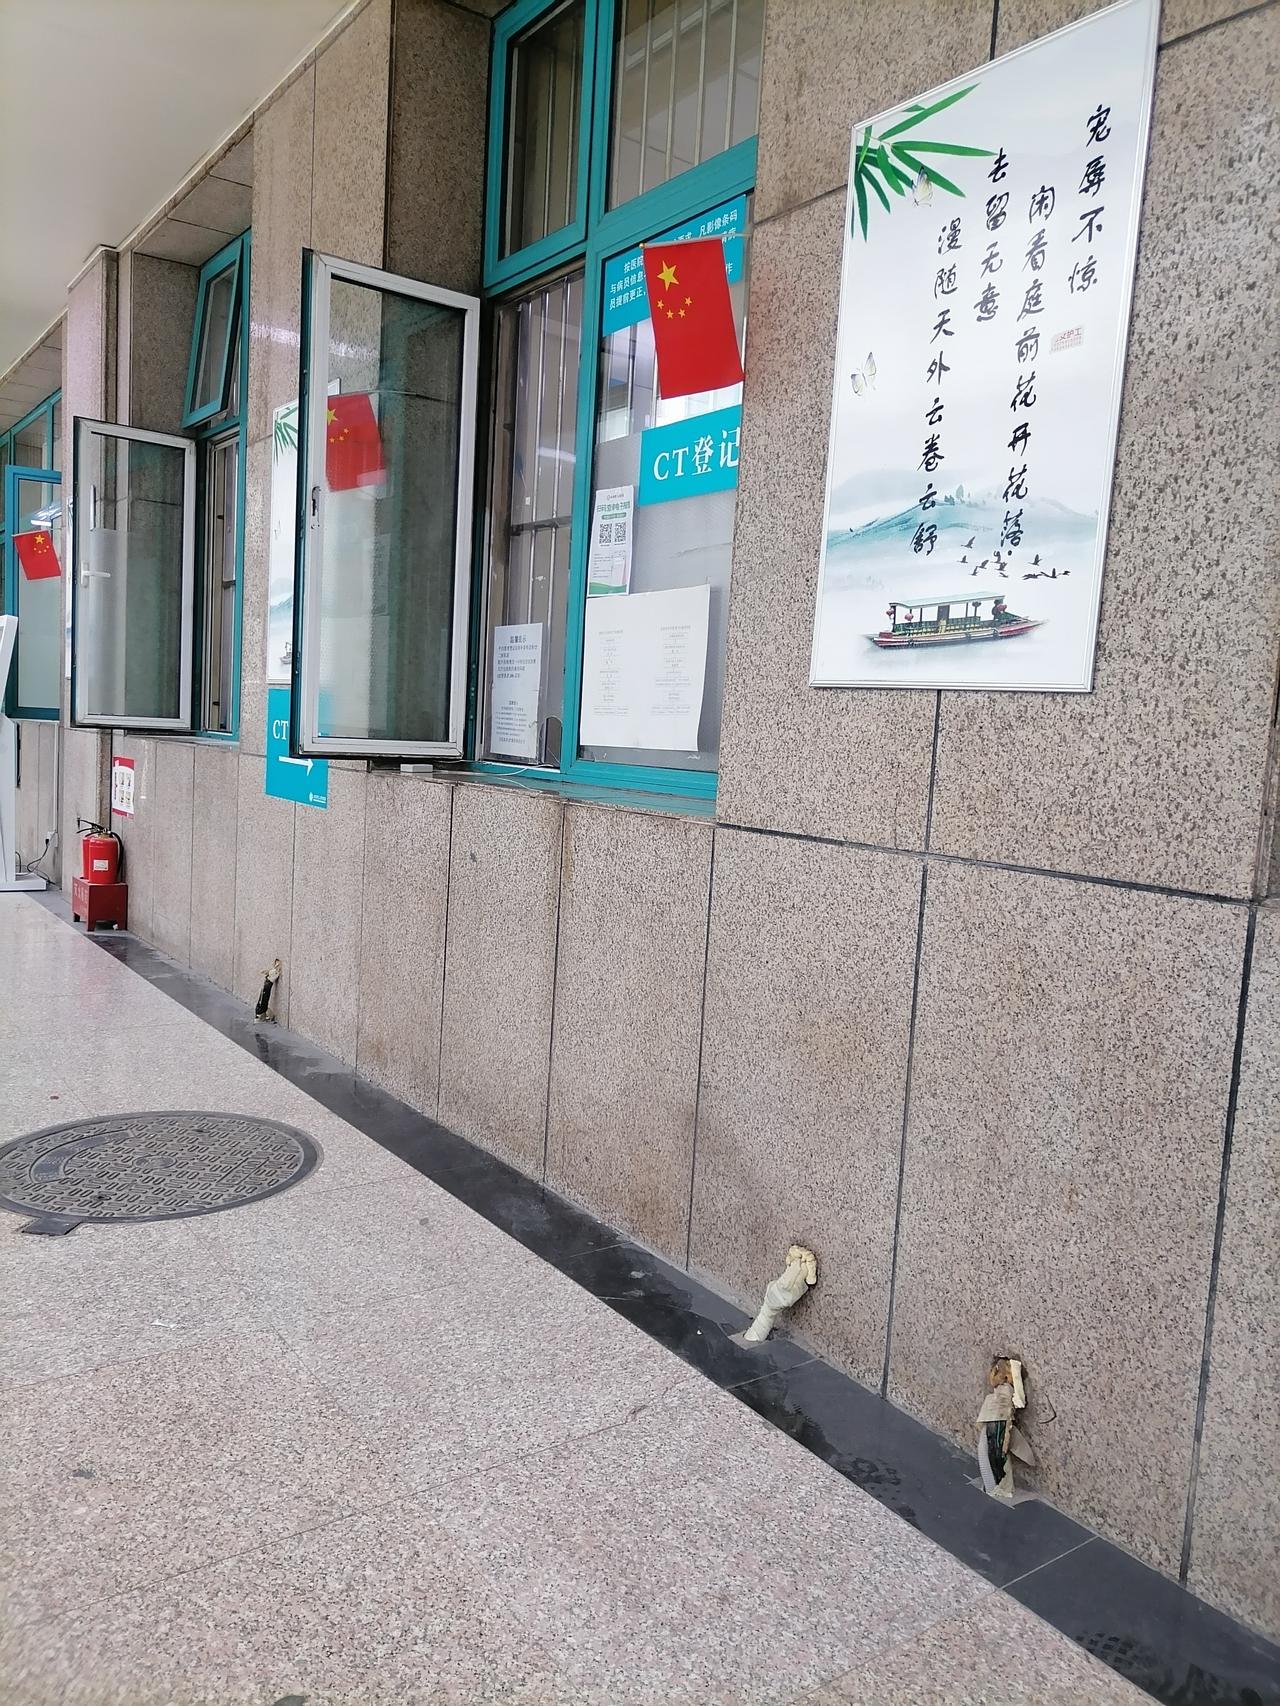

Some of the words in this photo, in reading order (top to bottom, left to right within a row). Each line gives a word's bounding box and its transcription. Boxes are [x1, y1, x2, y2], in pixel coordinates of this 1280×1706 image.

[973, 147, 1010, 322] 去留无意
[1068, 104, 1111, 294] 宠辱不惊
[653, 426, 739, 481] CT登记
[910, 216, 962, 556] 漫随天外云卷云舒
[272, 719, 289, 741] CT
